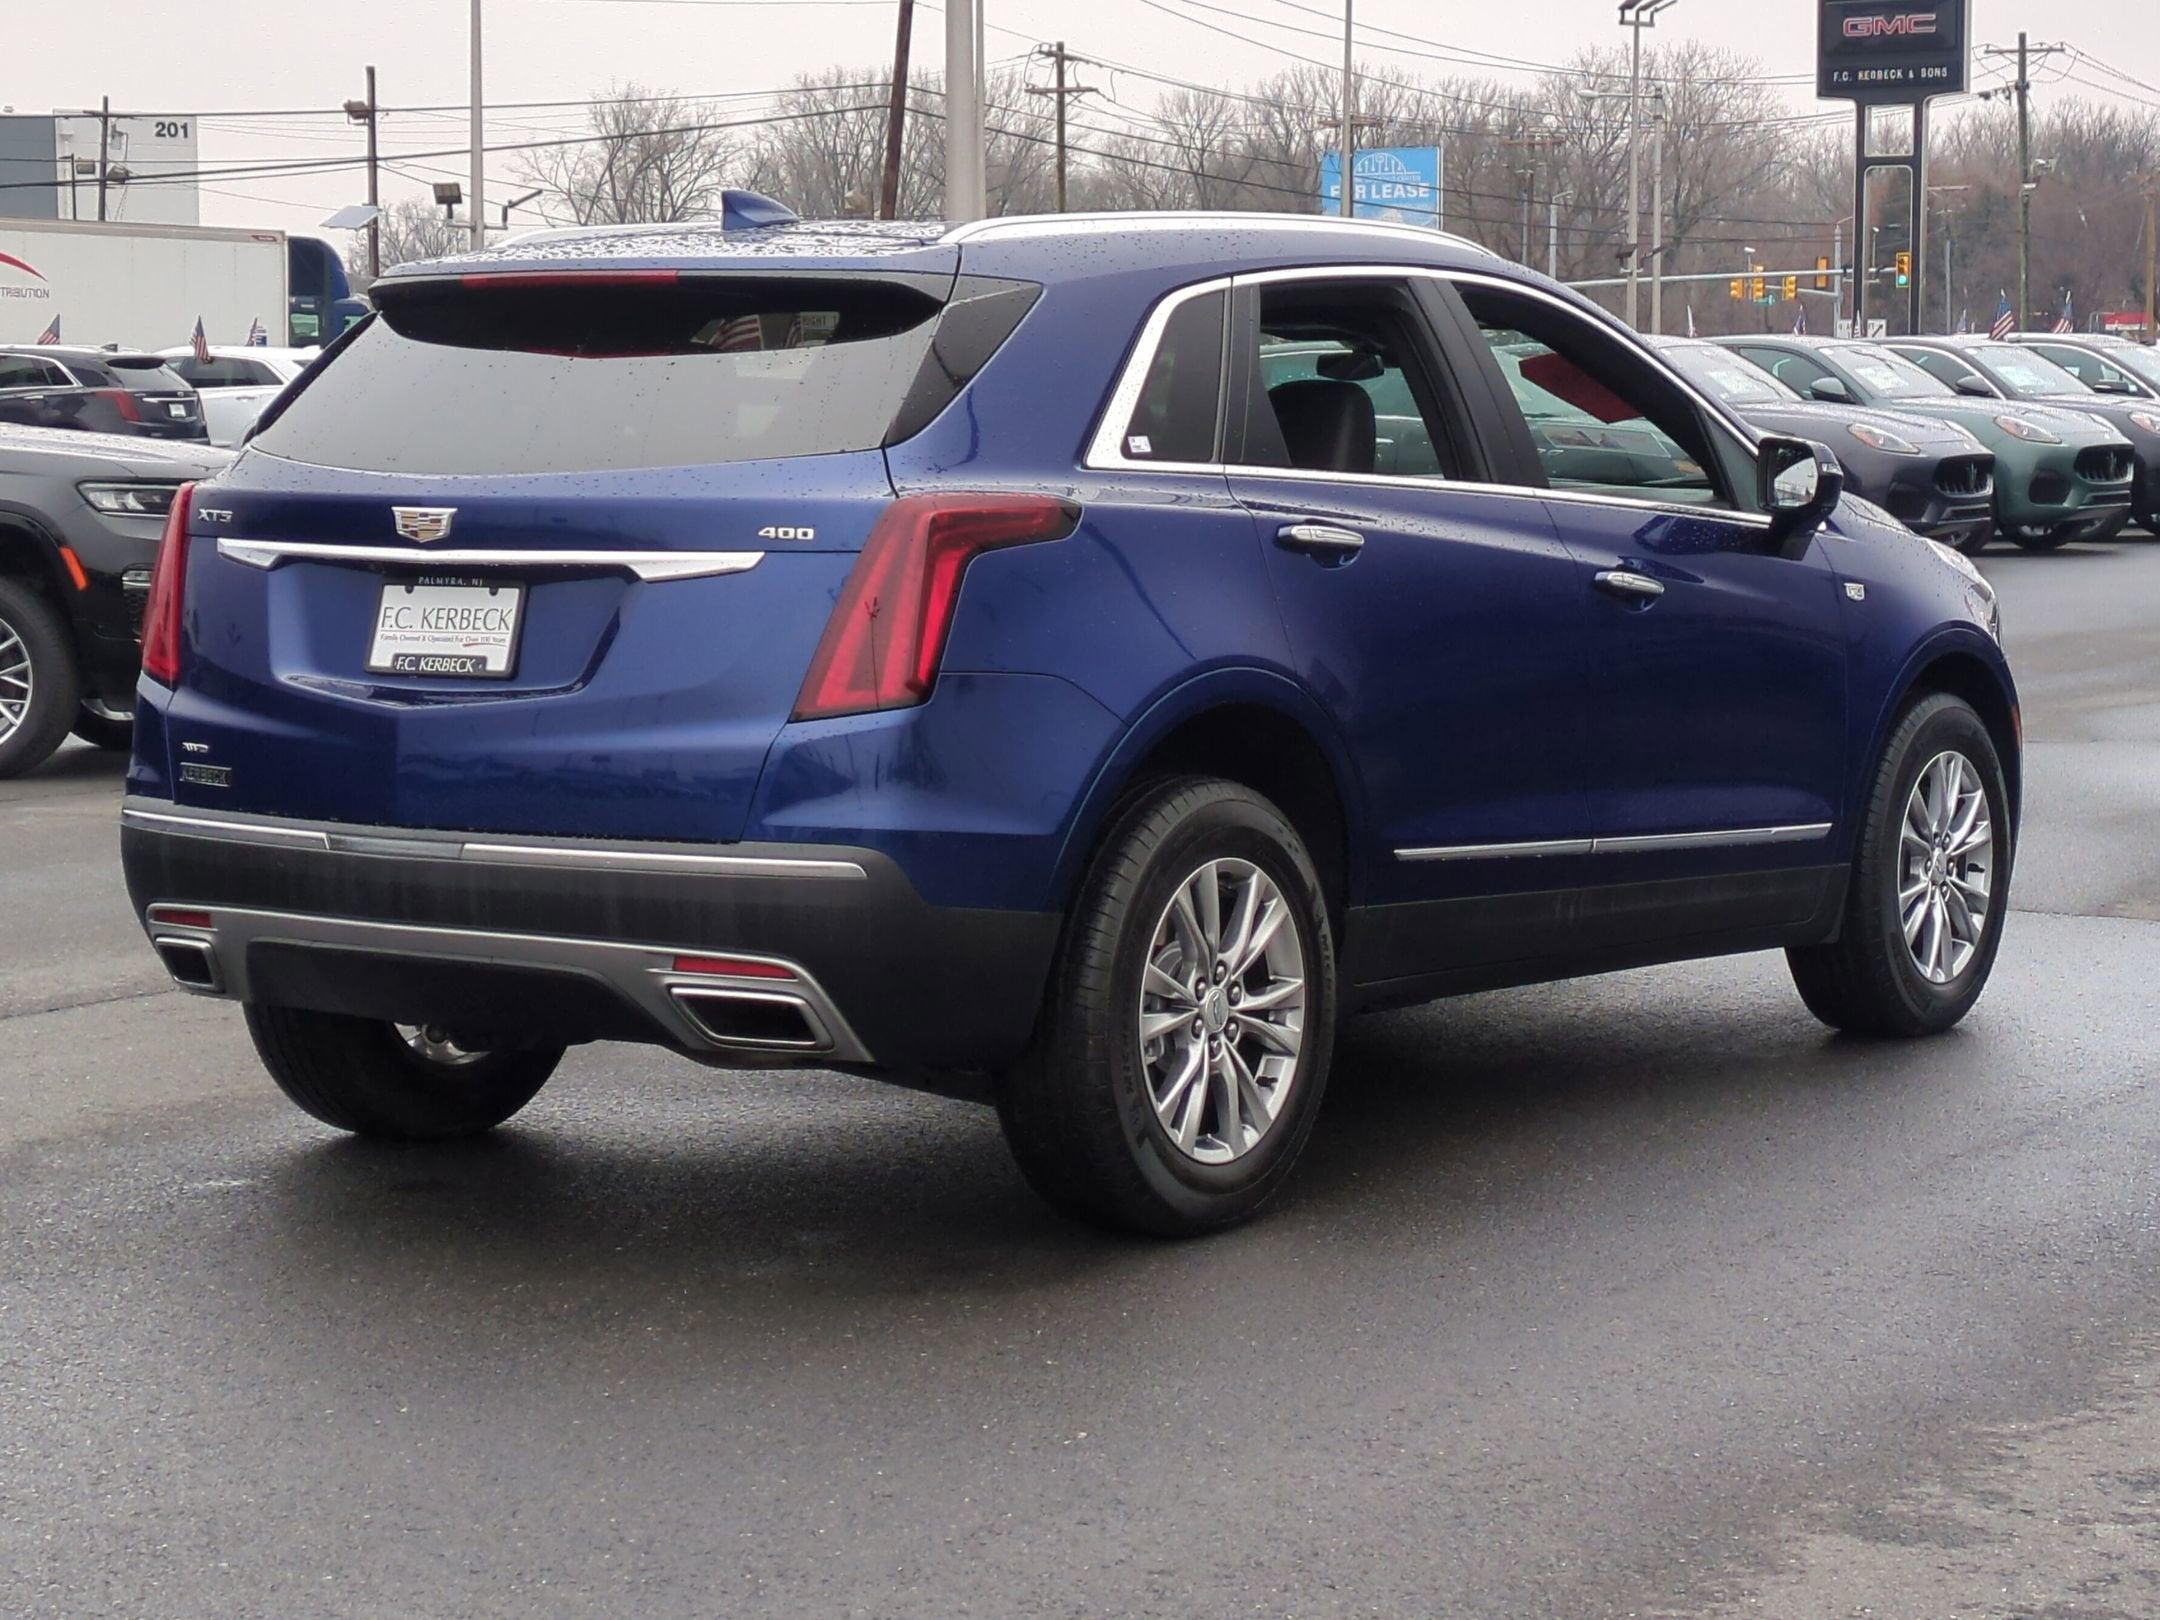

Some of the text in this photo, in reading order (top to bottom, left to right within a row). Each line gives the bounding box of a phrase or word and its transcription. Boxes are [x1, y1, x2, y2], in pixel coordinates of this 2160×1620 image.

[1842, 13, 1937, 37] GMC
[1857, 69, 1904, 81] KERBECK
[1920, 67, 1948, 78] SONS
[155, 121, 188, 139] 201
[1330, 183, 1430, 200] FR LEASE
[198, 508, 233, 522] XT5
[758, 527, 815, 541] 400
[471, 578, 484, 587] NJ
[381, 606, 513, 631] F.C. KERBECK
[395, 656, 476, 673] F.C. KERBECK
